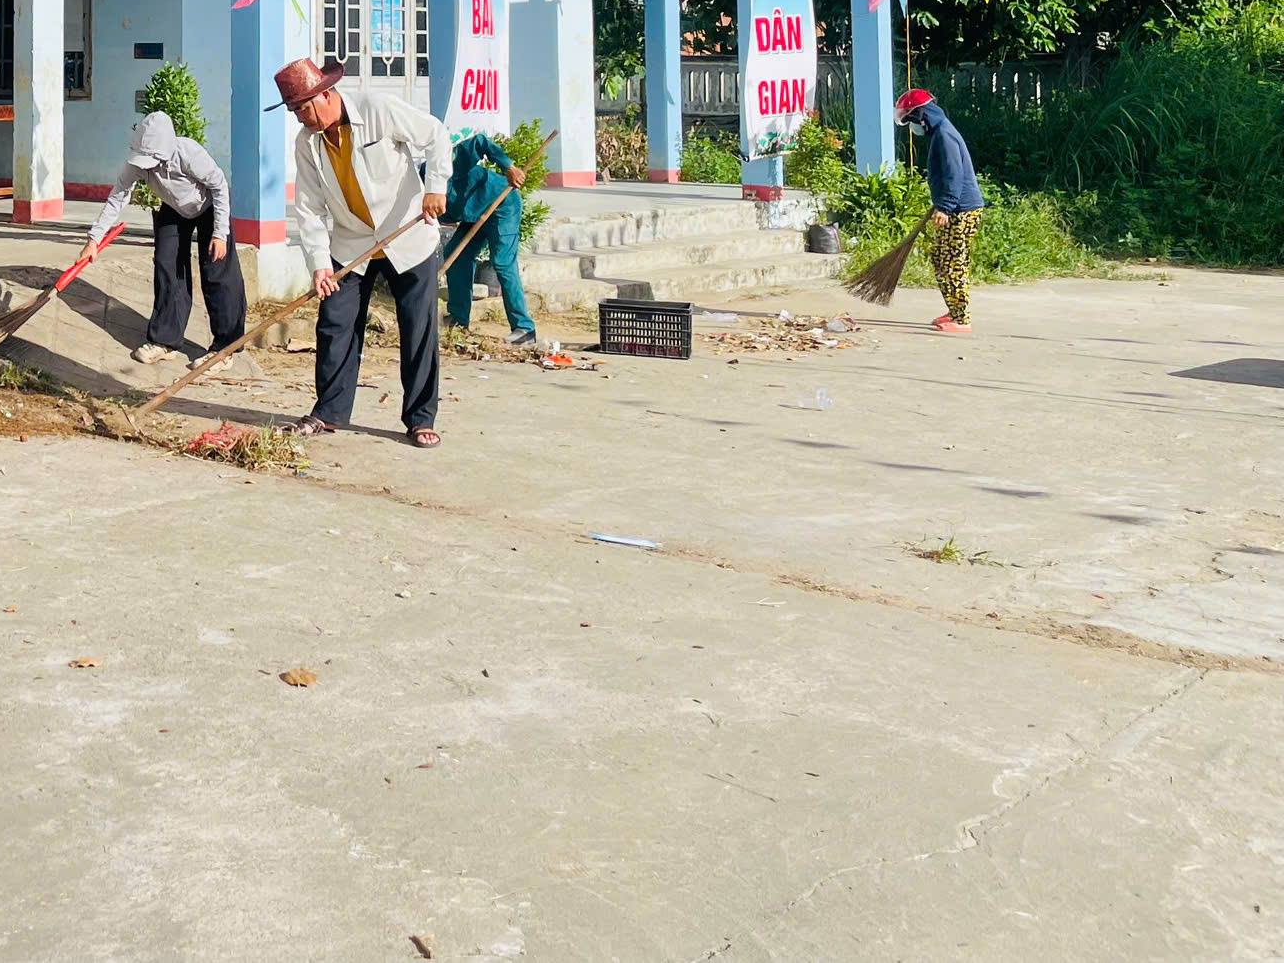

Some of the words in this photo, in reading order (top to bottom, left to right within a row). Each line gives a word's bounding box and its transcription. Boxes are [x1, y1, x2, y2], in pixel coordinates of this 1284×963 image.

[754, 8, 803, 52] DÂN
[460, 59, 500, 111] CHÒI
[757, 78, 806, 116] GIAN
